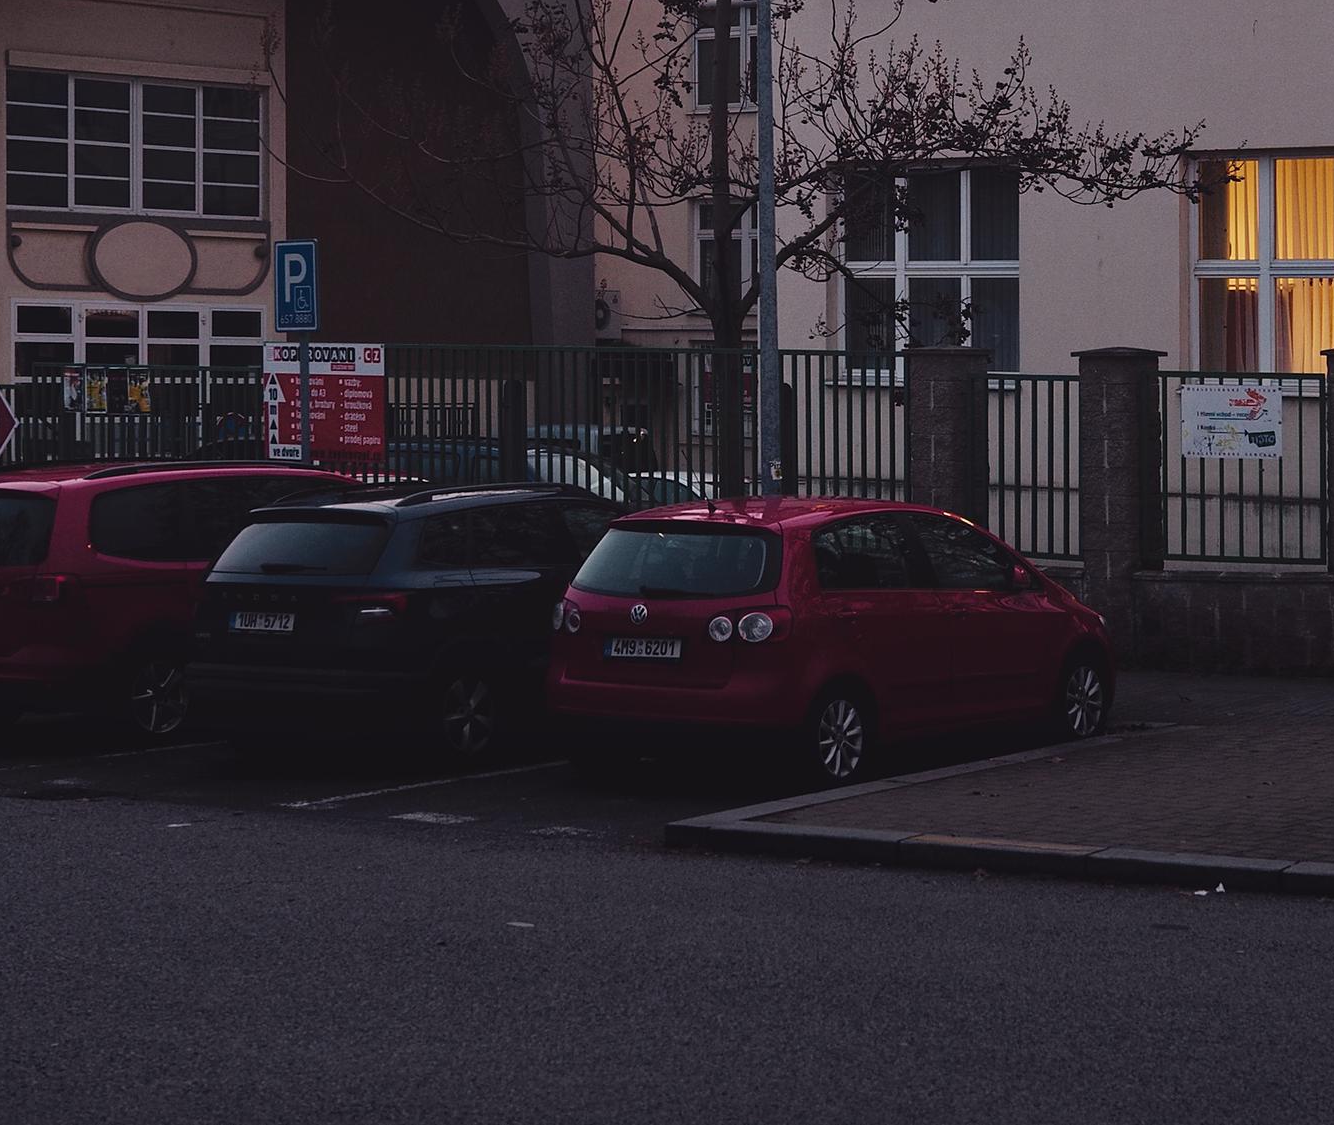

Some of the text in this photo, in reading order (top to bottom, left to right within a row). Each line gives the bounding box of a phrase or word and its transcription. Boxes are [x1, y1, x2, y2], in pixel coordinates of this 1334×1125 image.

[284, 252, 307, 303] P
[269, 388, 278, 401] 10
[272, 448, 281, 458] ve
[281, 446, 300, 458] dvoře
[239, 613, 291, 629] 1UH 5712
[614, 639, 676, 656] 4M9 6201
